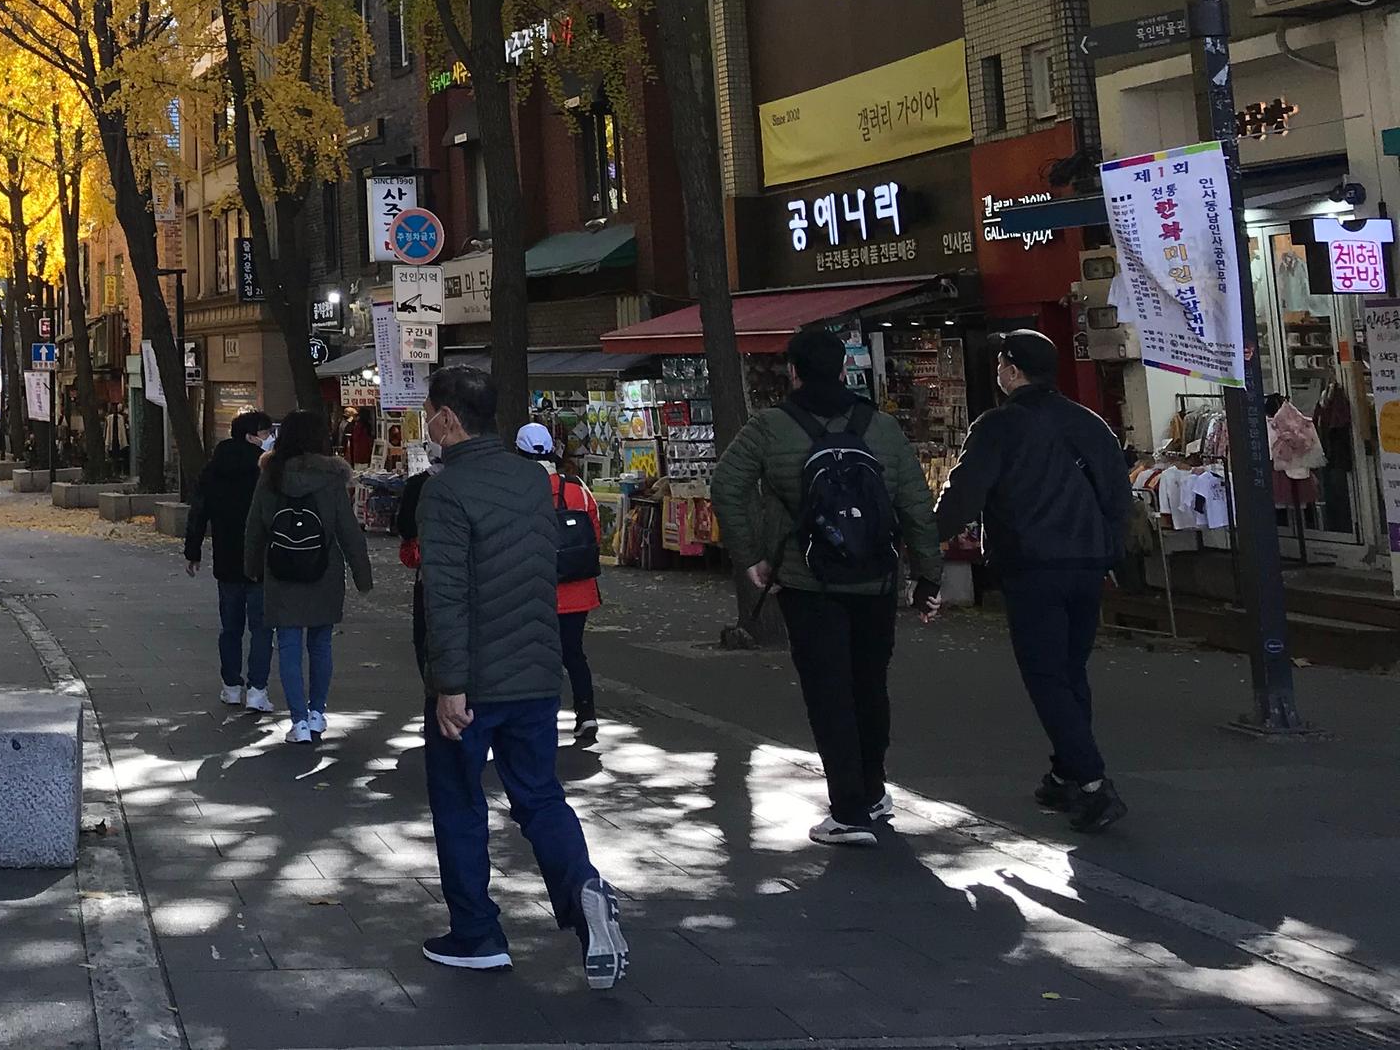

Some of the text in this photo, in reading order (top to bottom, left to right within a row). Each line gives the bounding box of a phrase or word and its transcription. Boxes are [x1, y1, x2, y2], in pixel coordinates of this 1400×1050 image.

[857, 86, 940, 143] 갤러리 가이아
[373, 177, 414, 185] SINCE 1990
[1151, 183, 1177, 201] 전통
[397, 232, 436, 242] 주정차금지
[1333, 243, 1378, 266] 체험
[399, 272, 438, 283] 견인지역
[1335, 265, 1380, 289] 공방
[405, 327, 433, 337] 구간내
[409, 351, 430, 359] 100m
